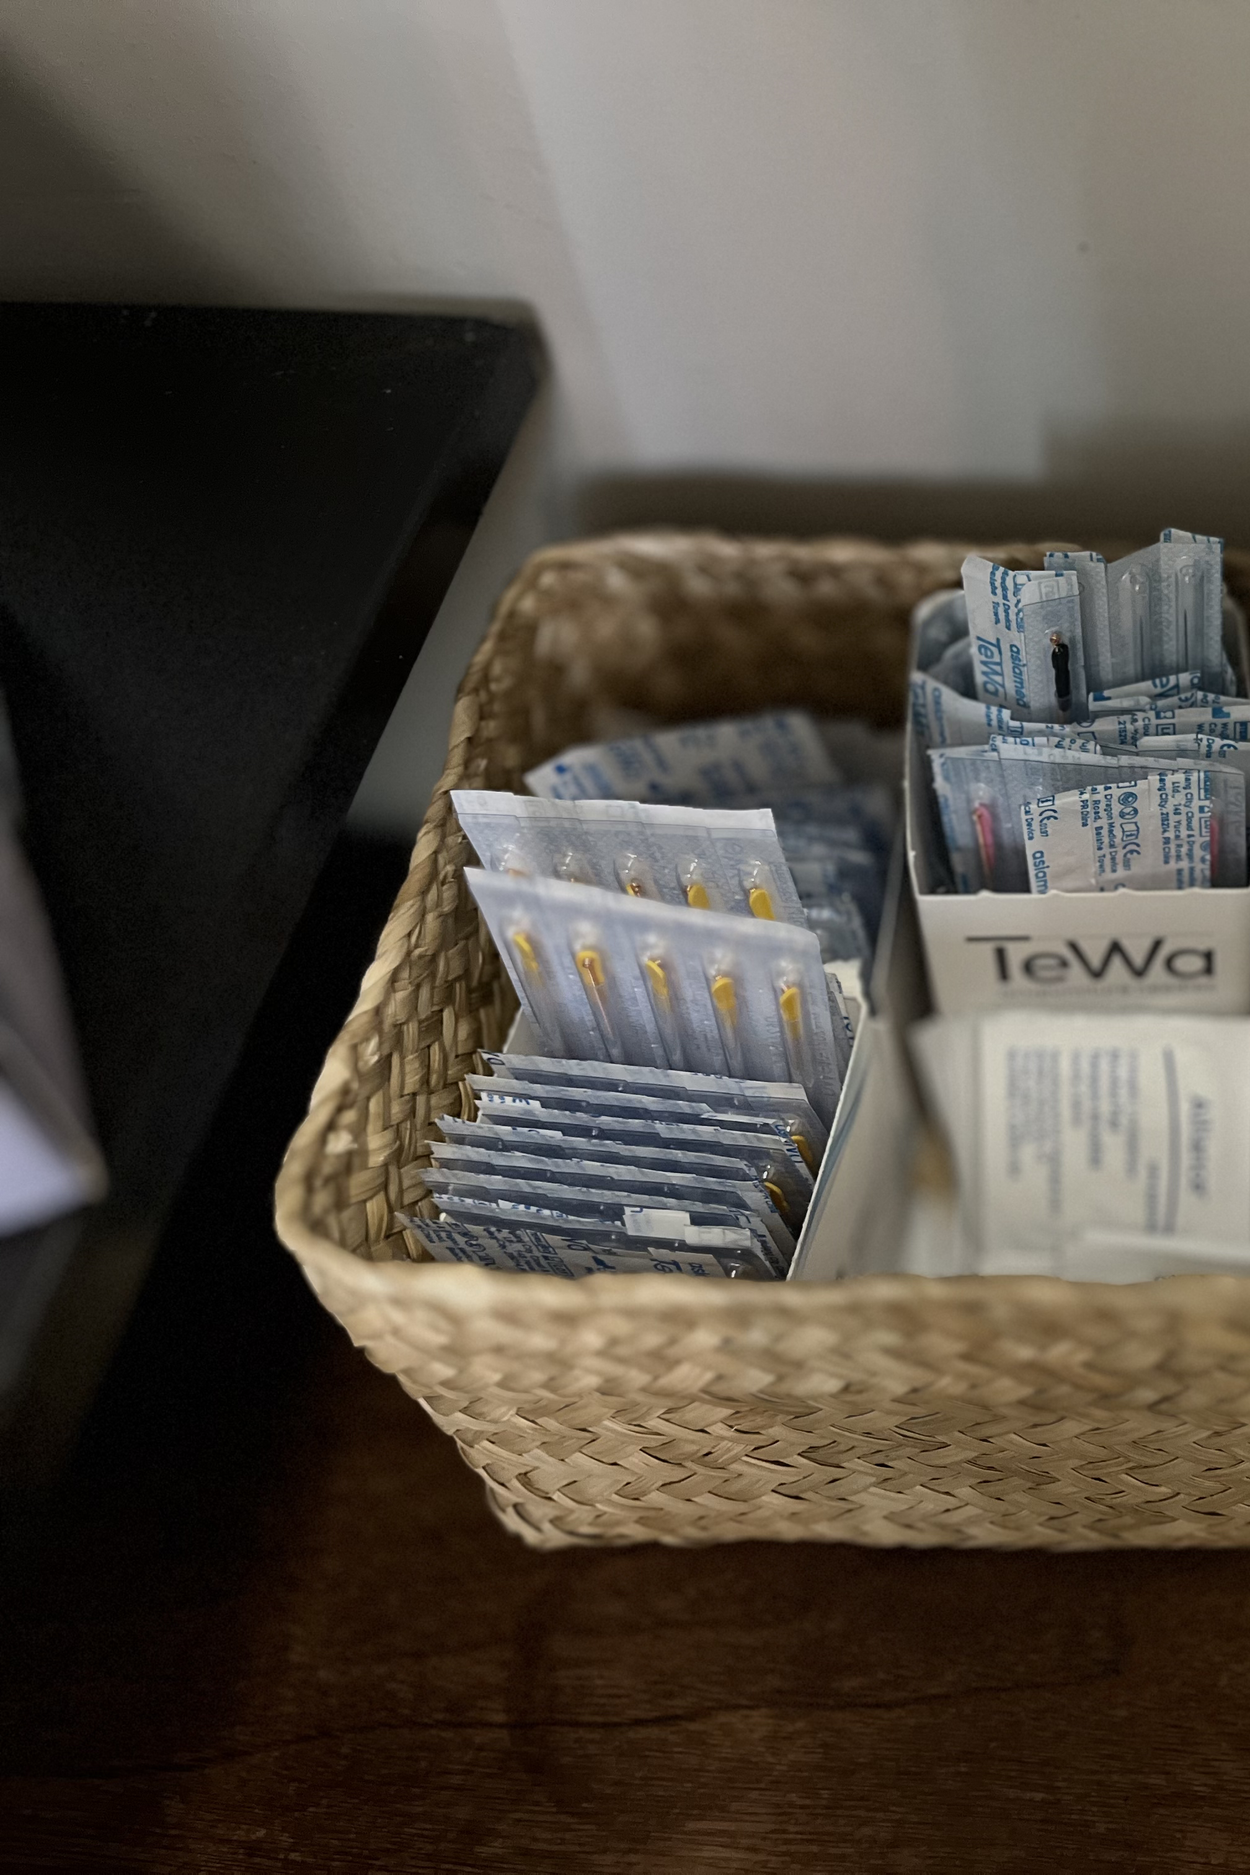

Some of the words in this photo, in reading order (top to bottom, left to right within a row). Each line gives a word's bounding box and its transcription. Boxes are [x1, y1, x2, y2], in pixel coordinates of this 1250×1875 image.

[975, 636, 1007, 703] TeWa
[1009, 644, 1030, 709] asiamed
[1103, 793, 1113, 821] Dragon
[1184, 792, 1194, 809] City
[1186, 811, 1195, 831] Cloud
[1107, 822, 1117, 849] Medical
[1110, 850, 1119, 873] Device
[965, 934, 1216, 985] TeWa
